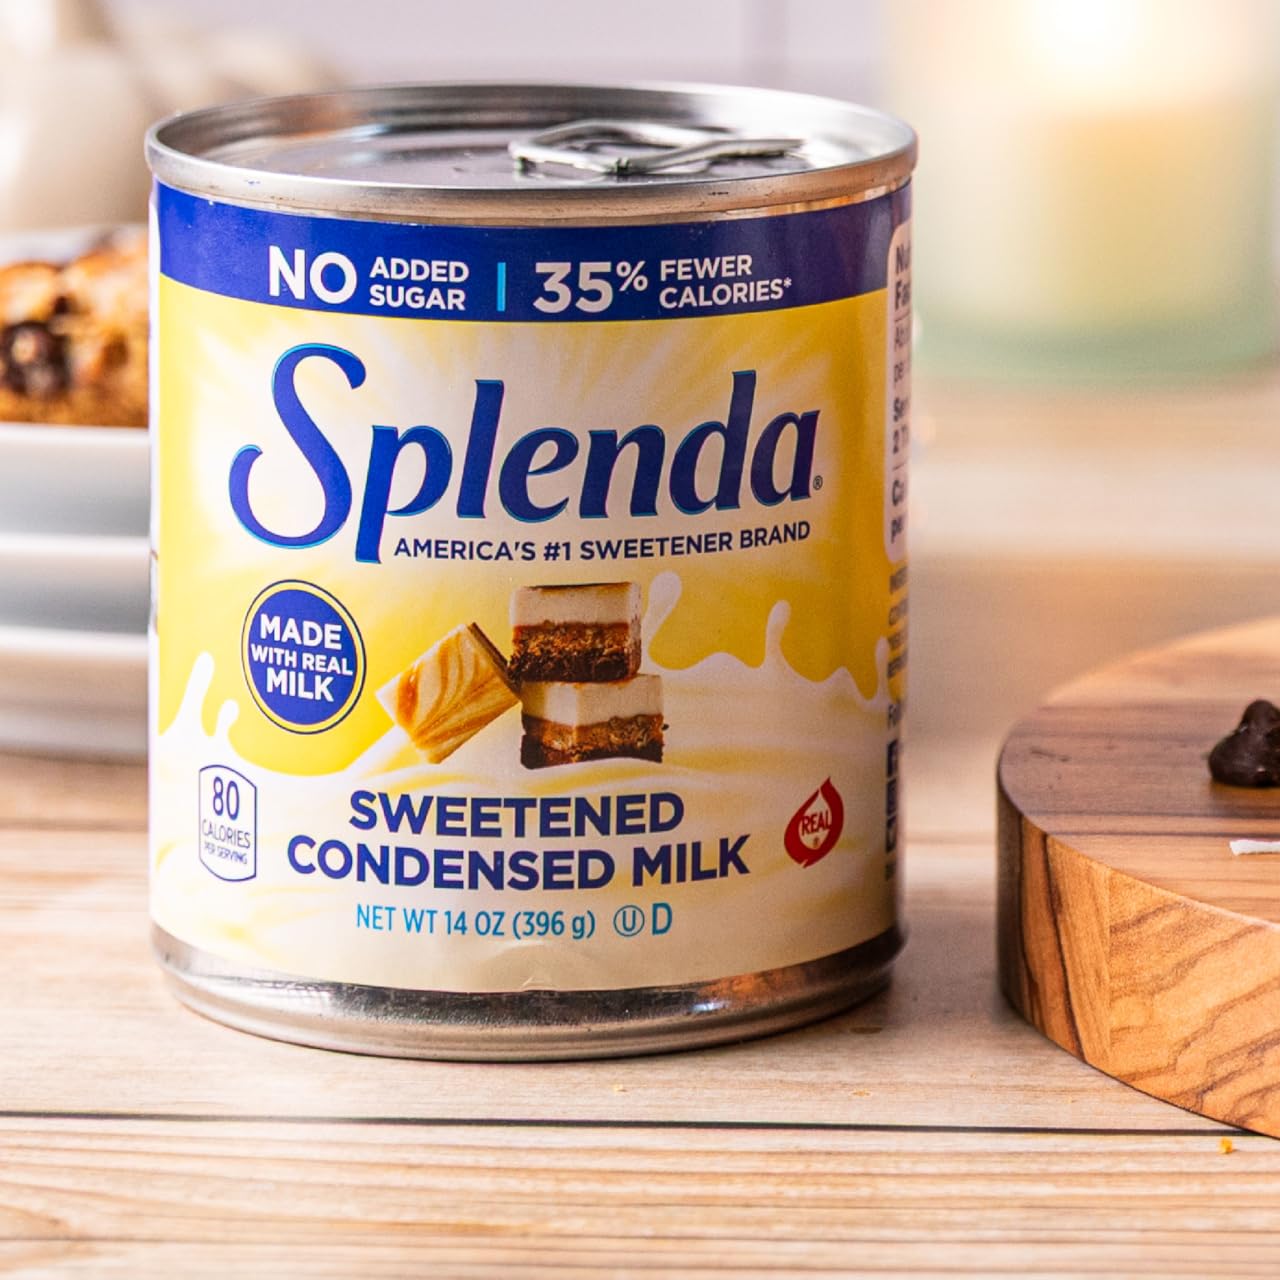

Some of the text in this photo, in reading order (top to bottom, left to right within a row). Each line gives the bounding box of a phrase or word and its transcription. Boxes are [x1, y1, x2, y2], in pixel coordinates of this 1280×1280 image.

[268, 245, 357, 305] NO
[369, 256, 469, 283] ADDED
[533, 260, 648, 314] 35%
[659, 255, 753, 282] FEWER
[369, 286, 466, 311] SUGAR
[394, 520, 811, 562] AMERICA'S #1 SWEETENER BRAND
[260, 613, 342, 651] MADE
[251, 643, 353, 677] WITH REAL
[266, 667, 334, 703] MILK
[212, 776, 240, 821] 80
[349, 790, 684, 838] SWEETENED
[202, 818, 251, 849] CALORIES
[801, 809, 831, 836] REAL
[287, 834, 750, 890] CONDENSED MILK
[356, 903, 597, 940] NET WT 14 OZ (396 g)
